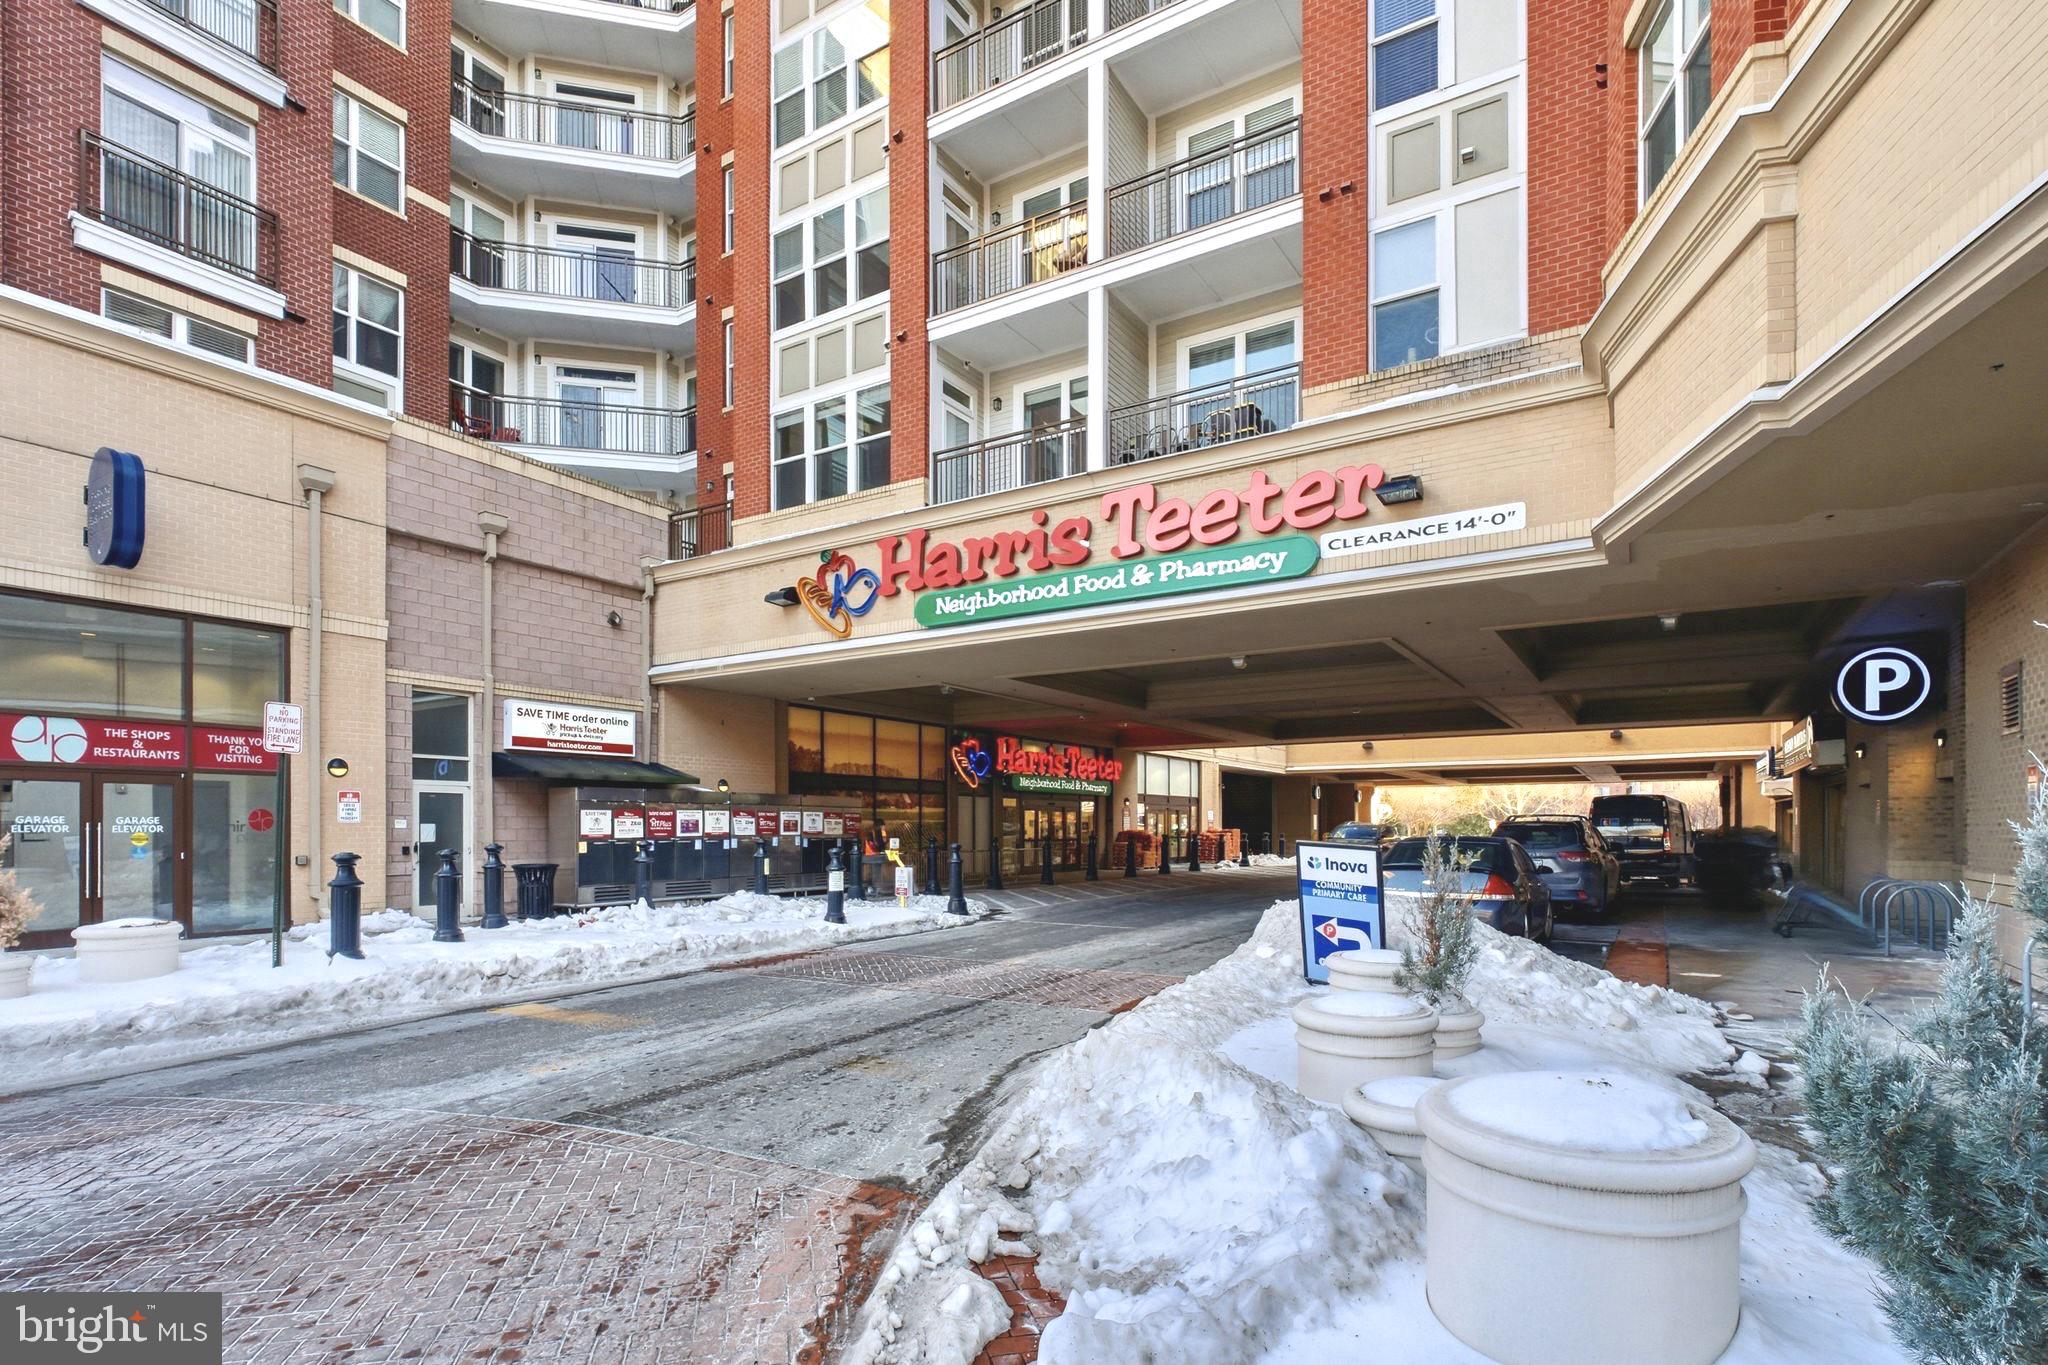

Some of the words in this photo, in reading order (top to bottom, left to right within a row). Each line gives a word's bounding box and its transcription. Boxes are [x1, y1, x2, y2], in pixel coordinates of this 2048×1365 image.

[876, 511, 1091, 597] Harris
[1101, 463, 1385, 559] Teeter
[1328, 522, 1450, 550] CLEARANCE
[935, 578, 1069, 615] Neighborhood
[1073, 568, 1127, 595] Food
[1130, 564, 1154, 586] &
[1158, 551, 1288, 582] Pharmacy
[1865, 659, 1911, 712] P
[279, 709, 289, 717] NO
[517, 707, 543, 719] SAVE
[545, 710, 570, 721] TIME
[572, 714, 598, 724] order
[600, 717, 629, 727] online
[269, 715, 298, 725] PARKING
[104, 728, 128, 739] THE
[130, 729, 171, 741] SHOPS
[267, 727, 300, 736] STANDING
[560, 724, 583, 733] Harris
[132, 739, 144, 749] &
[207, 734, 245, 746] THANK
[248, 737, 263, 747] YO
[267, 734, 281, 743] FIRE
[282, 736, 300, 745] LANE
[93, 747, 180, 760] RESTAURANTS
[228, 744, 250, 754] FOR
[215, 754, 263, 764] VISITING
[996, 736, 1066, 777] Harris
[1065, 745, 1123, 782] Teeter
[1019, 777, 1060, 790] Neighborhood
[1061, 780, 1075, 790] Food
[1081, 781, 1108, 794] Pharmacy
[15, 815, 66, 825] GARAGE
[115, 816, 160, 825] GARAGE
[11, 824, 70, 833] ELEVATOR
[112, 824, 164, 833] ELEVATOR
[1325, 857, 1368, 874] Inova
[1315, 881, 1362, 893] COMMUNITY
[1312, 888, 1346, 900] PRIMARY
[1347, 892, 1367, 902] CARE
